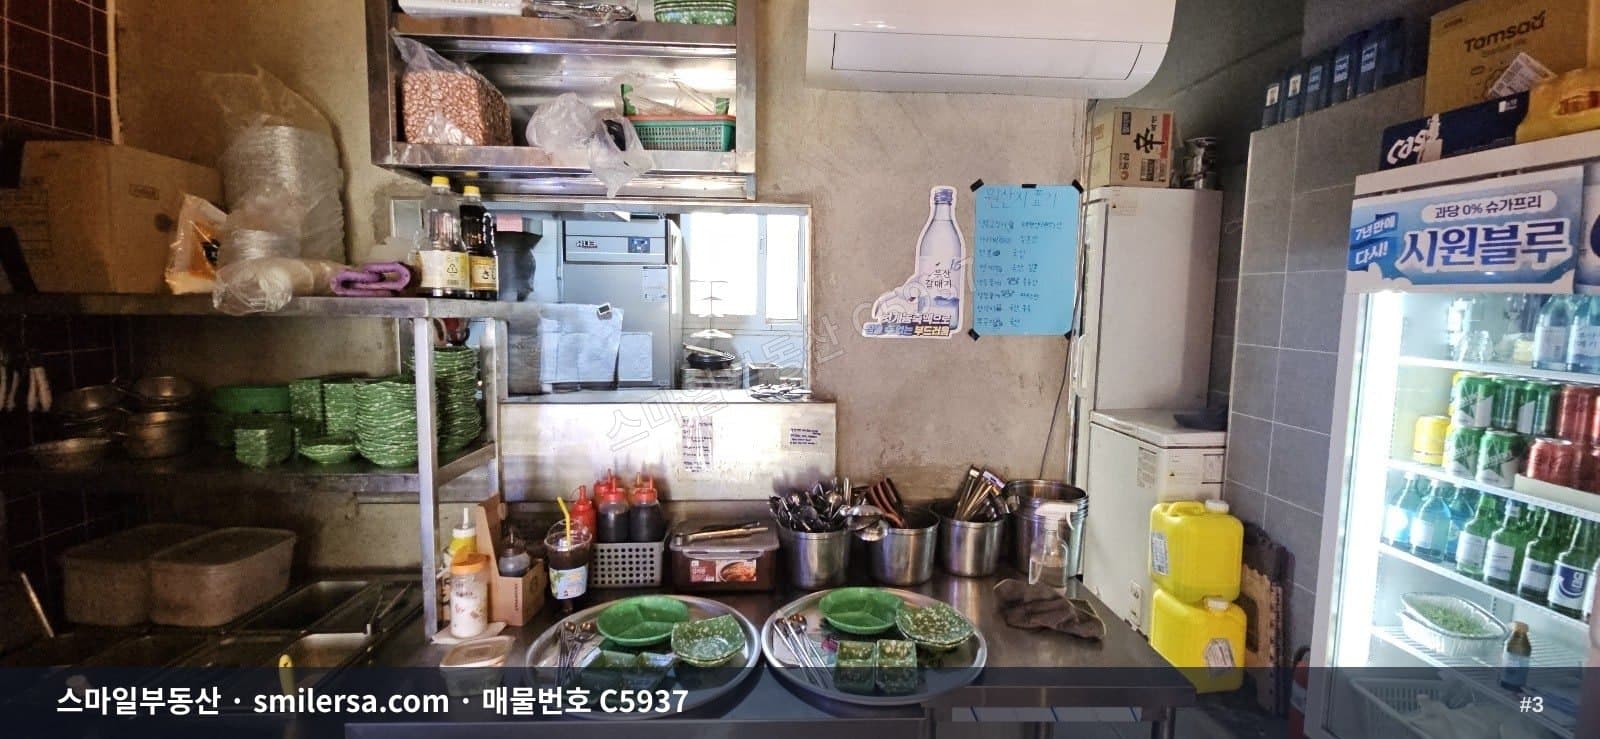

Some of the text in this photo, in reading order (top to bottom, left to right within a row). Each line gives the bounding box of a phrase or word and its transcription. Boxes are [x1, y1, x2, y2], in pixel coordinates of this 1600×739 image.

[1434, 194, 1542, 219] 과당 0% 슈가프리
[1354, 241, 1389, 265] 다시!
[1400, 221, 1568, 267] 시원블루
